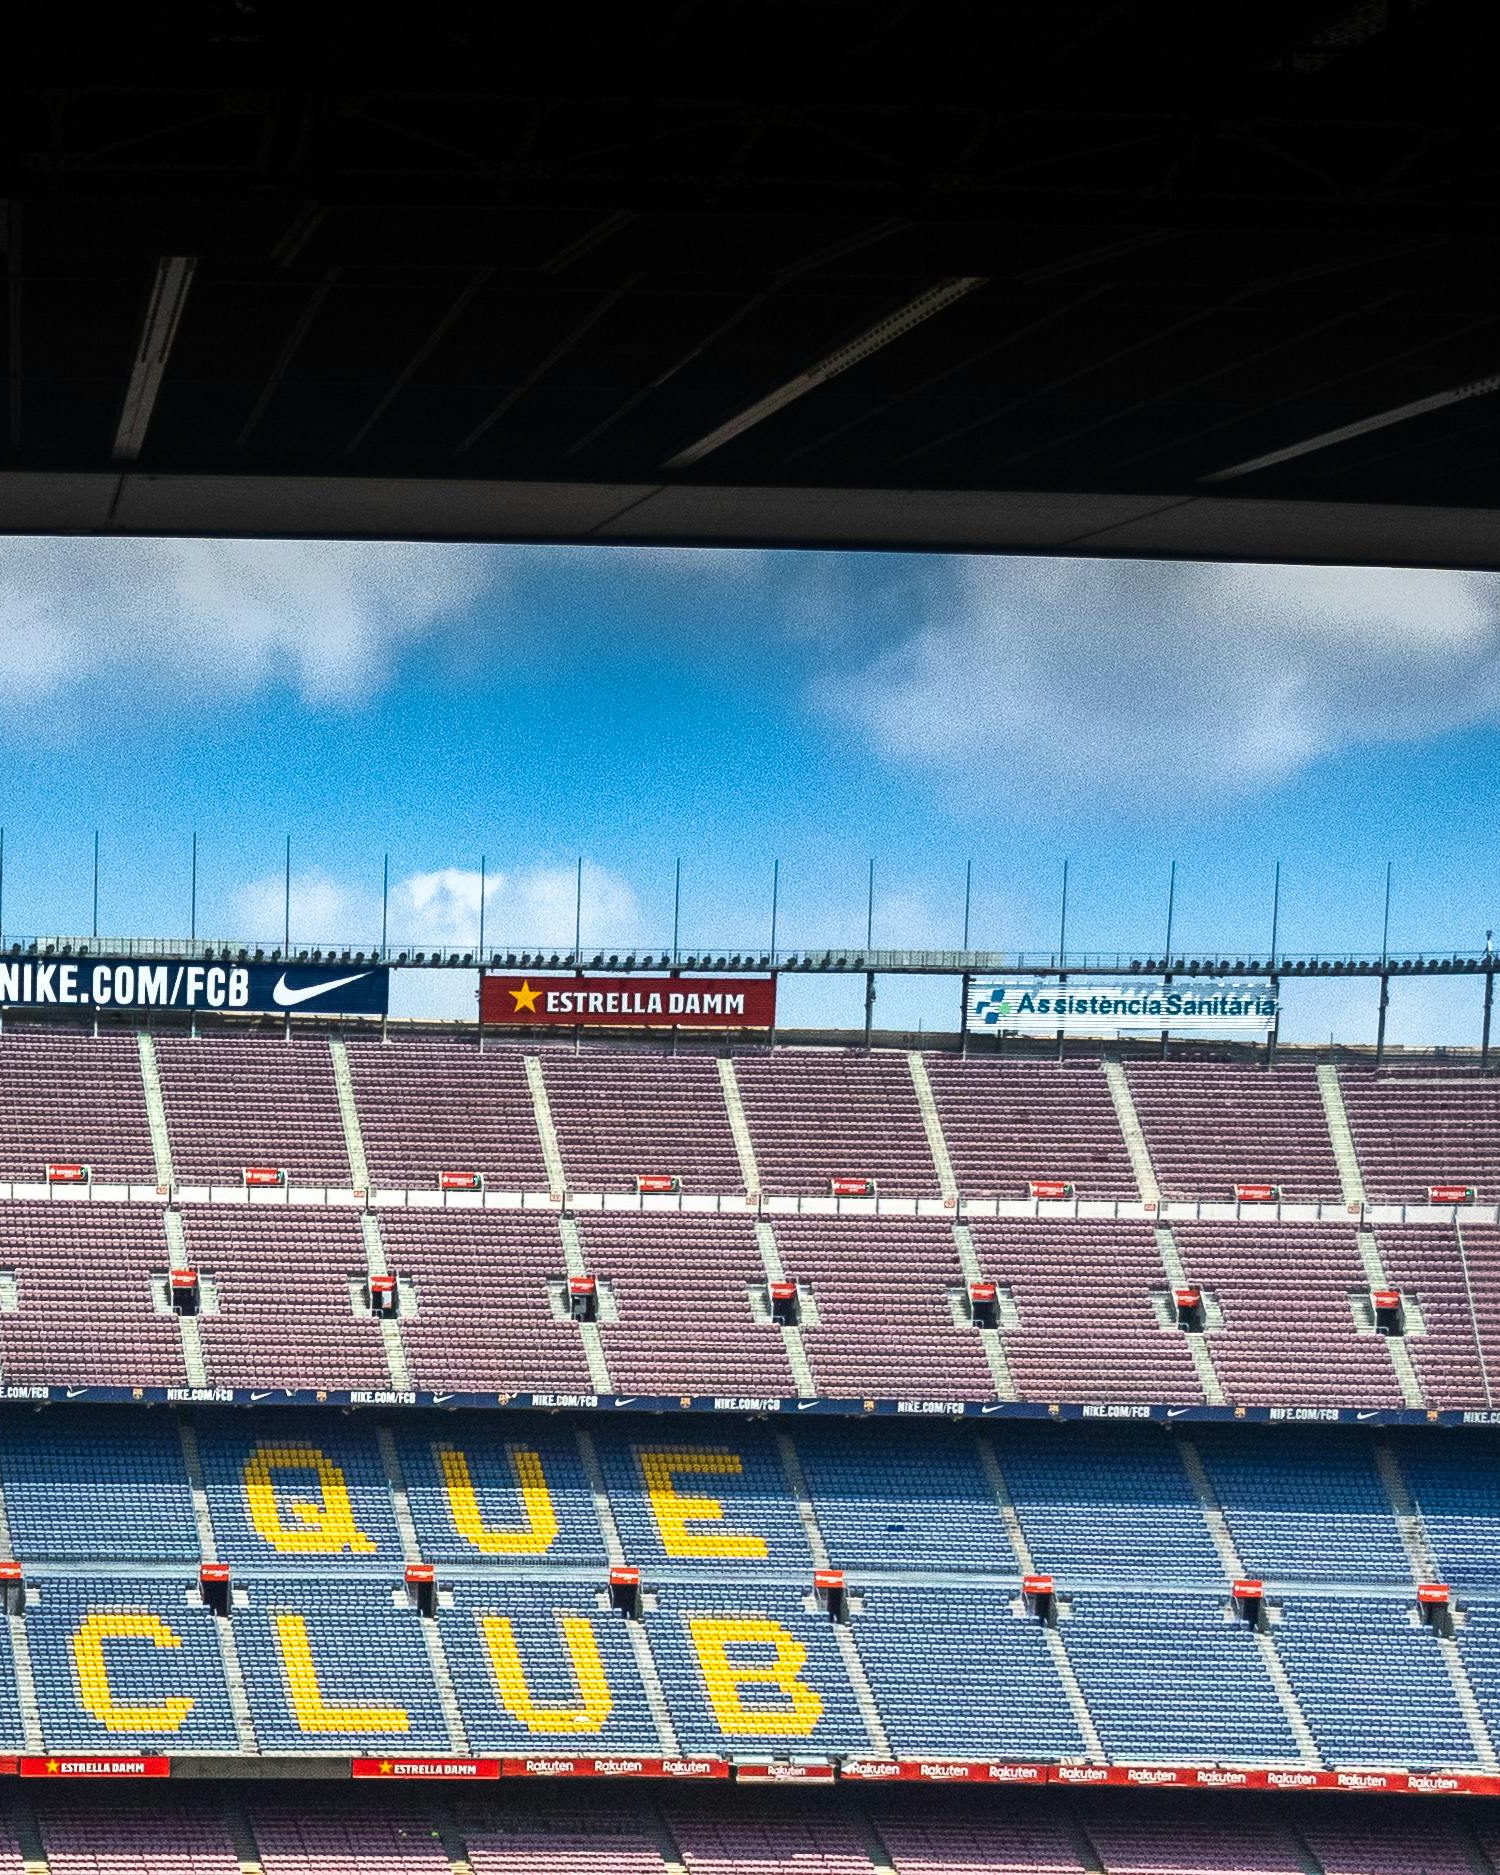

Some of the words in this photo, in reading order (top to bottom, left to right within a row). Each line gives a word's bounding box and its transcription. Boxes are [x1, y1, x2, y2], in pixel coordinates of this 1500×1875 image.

[546, 993, 661, 1014] ESTRELLA
[668, 994, 744, 1015] DAMM
[1017, 994, 1160, 1016] Assistència
[1166, 995, 1275, 1017] Sanitària
[245, 1444, 768, 1557] QUE
[72, 1612, 823, 1735] CLUB
[61, 1762, 110, 1773] ESTRELLA
[113, 1762, 144, 1773] DAMM
[394, 1764, 444, 1775] ESTRELLA
[447, 1764, 476, 1775] DAMM
[527, 1760, 573, 1775] Rakuten
[595, 1760, 644, 1776] Rakuten
[662, 1761, 710, 1776] Rakuten
[767, 1766, 806, 1776] Rakuten
[852, 1762, 900, 1778] Rakuten
[921, 1765, 968, 1779] Rakuten
[990, 1766, 1037, 1780] Rakuten
[1059, 1767, 1107, 1782] Rakuten
[1128, 1769, 1176, 1786] Rakuten
[1198, 1771, 1246, 1785] Rakuten
[1268, 1773, 1316, 1788] Rakuten
[1338, 1774, 1386, 1789] Rakuten
[1408, 1777, 1457, 1792] Rakuten
